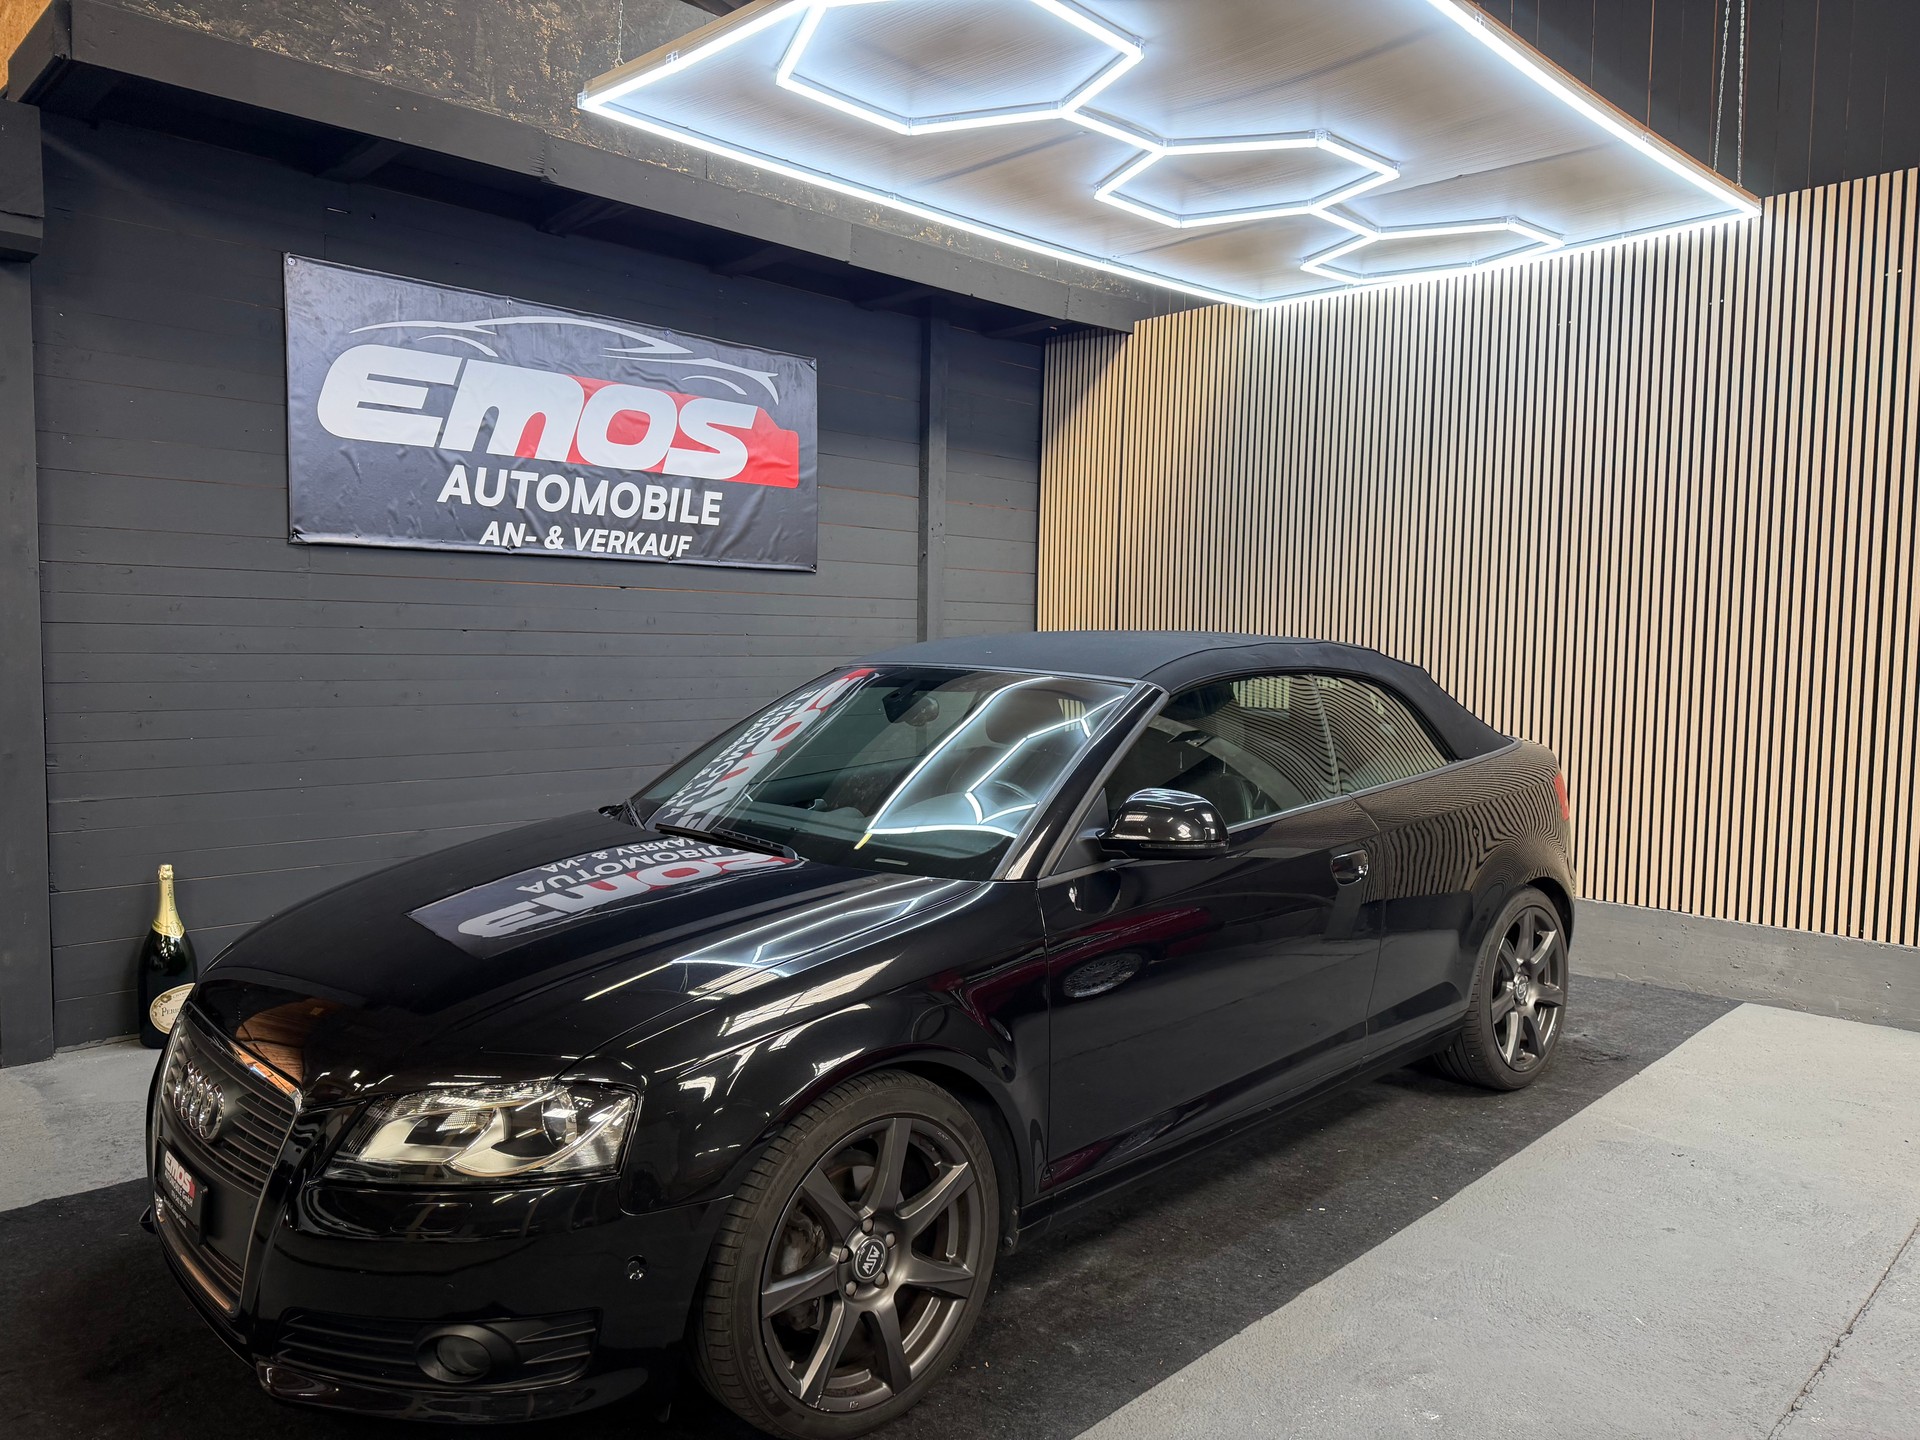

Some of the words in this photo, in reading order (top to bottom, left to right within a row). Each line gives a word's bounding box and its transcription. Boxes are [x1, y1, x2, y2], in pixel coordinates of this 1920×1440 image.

[437, 464, 724, 526] AUTOMOBILE
[479, 519, 537, 547] AN-
[544, 524, 564, 550] &
[574, 526, 693, 558] VERKAUF
